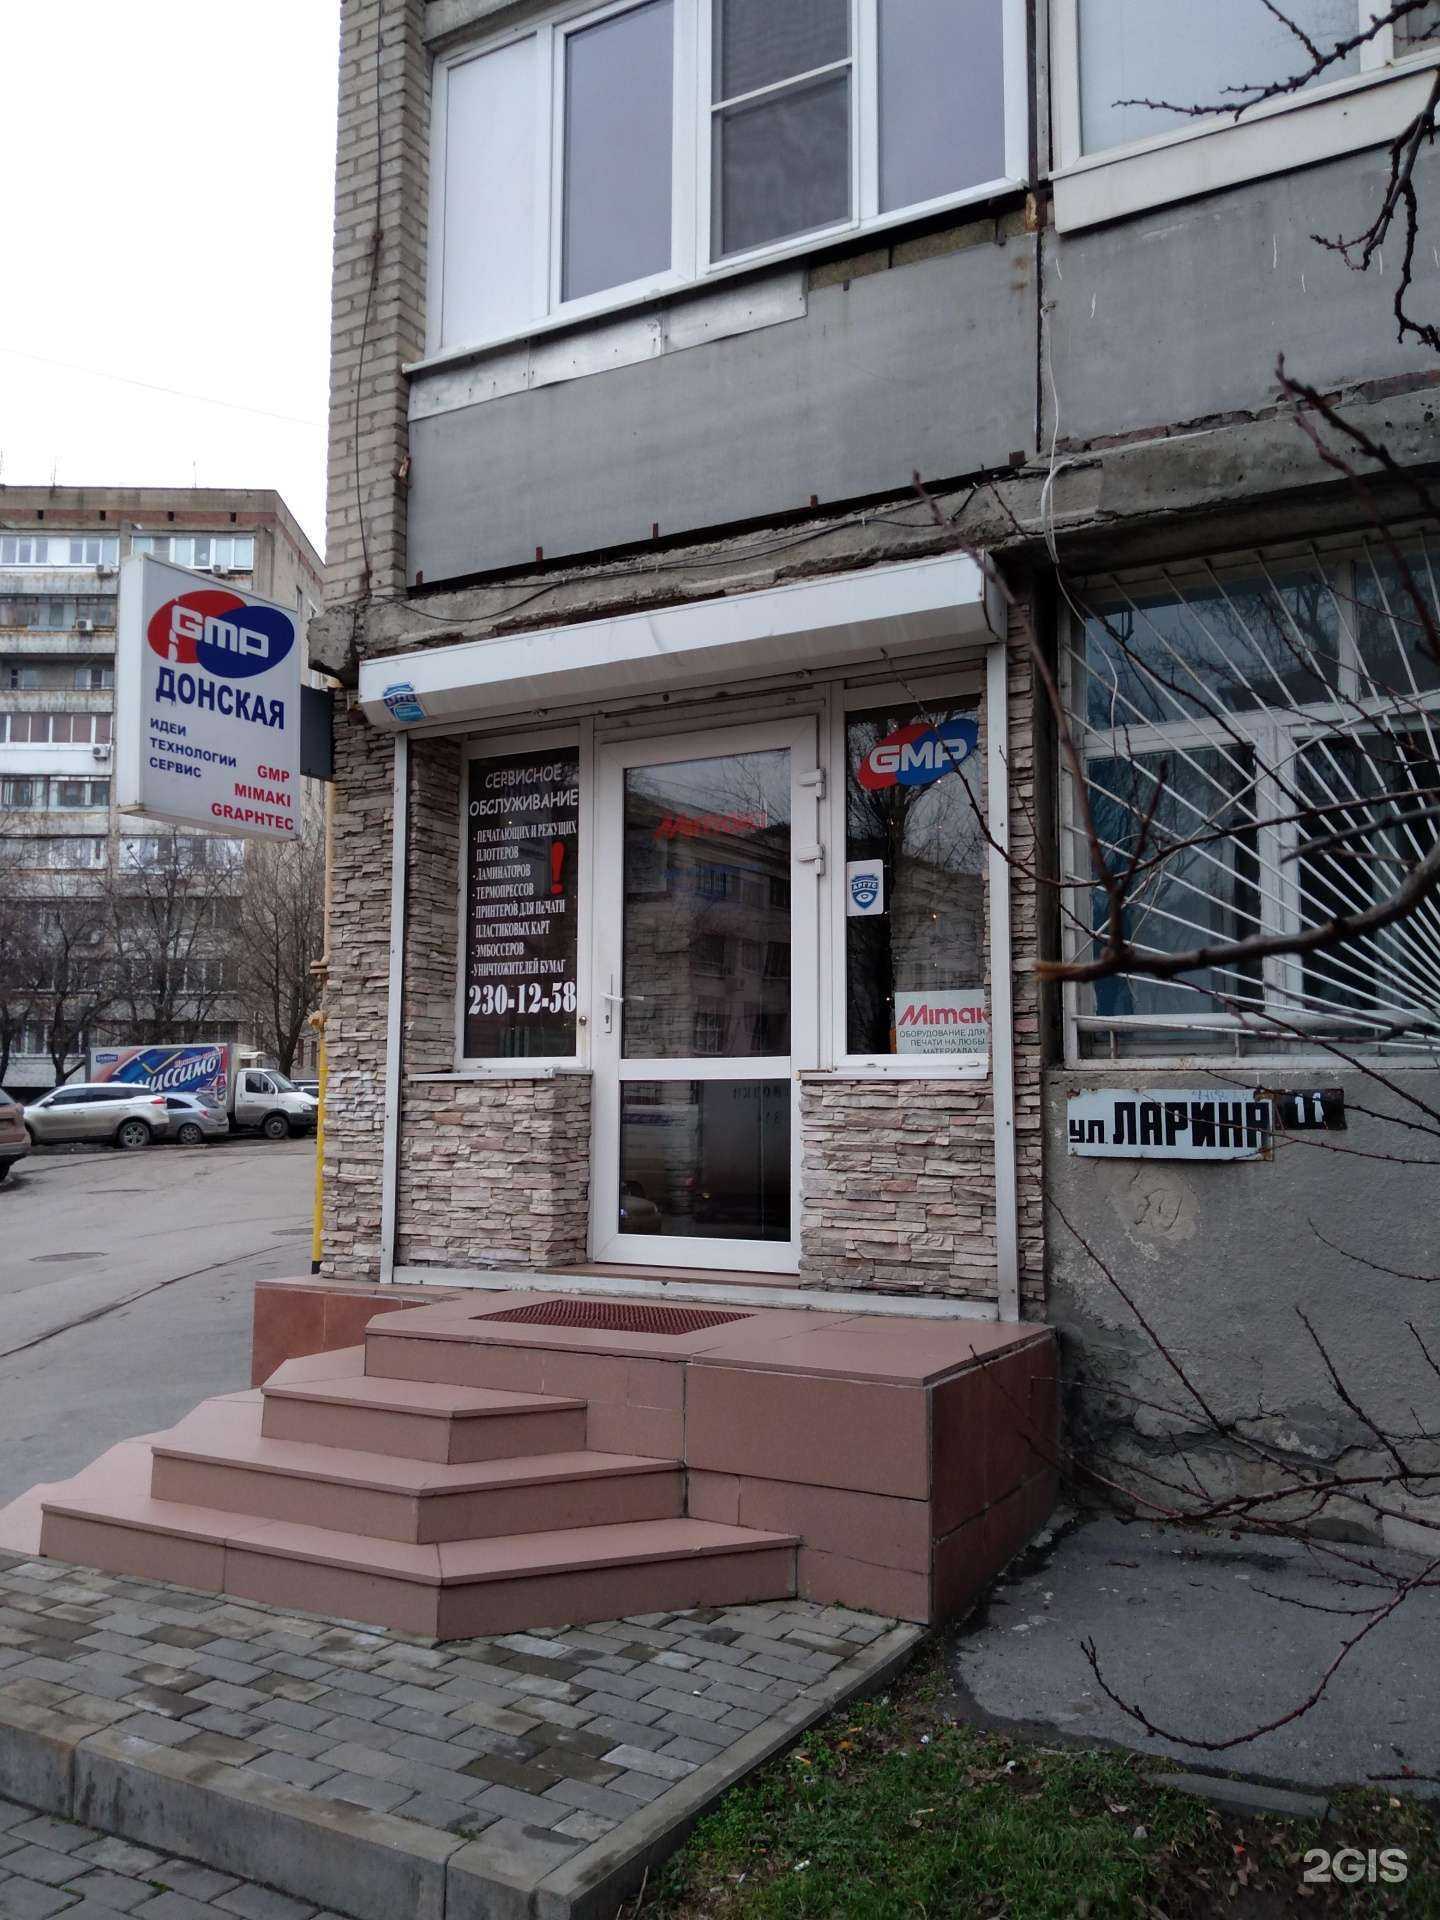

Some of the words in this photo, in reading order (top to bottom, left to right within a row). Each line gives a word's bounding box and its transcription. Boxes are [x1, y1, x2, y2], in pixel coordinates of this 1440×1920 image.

[172, 604, 269, 659] GMP
[155, 666, 284, 730] ДОНСКАЯ
[150, 717, 187, 738] ИДЕИ
[150, 736, 237, 768] ТЕХНОЛОГИИ
[869, 738, 968, 775] GMP
[150, 756, 202, 779] СЕРВИС
[256, 764, 290, 784] GMP
[485, 762, 562, 789] СЕРВИСНОЕ
[233, 782, 291, 808] MIMAKI
[469, 788, 579, 817] ОБСЛУЖИВАНИЕ
[210, 801, 294, 832] GRAPHTEC
[530, 824, 537, 838] И
[476, 845, 519, 863] ПЛОТТЕРОВ
[476, 863, 531, 881] ЛАМИНАТОРОВ
[476, 882, 534, 900] ТЕРМОПРЕССОВ
[475, 903, 519, 919] ПРИНТЕРОВ
[519, 902, 536, 917] ДЛЯ
[475, 922, 530, 939] ПЛАСТИКОВЫХ
[531, 920, 551, 936] КАРТ
[475, 942, 525, 958] ЭМБОССЕРОВ
[473, 957, 539, 977] УНИЧТОЖИТЕЛЕЙ
[539, 959, 567, 974] БУМАГ
[468, 981, 577, 1015] 230-12-58
[900, 1029, 964, 1039] ОБОРУДОВАНИЕ
[911, 1039, 942, 1047] ПЕЧАТИ
[1069, 1119, 1109, 1145] ул.
[1112, 1101, 1270, 1148] ЛАРИНА
